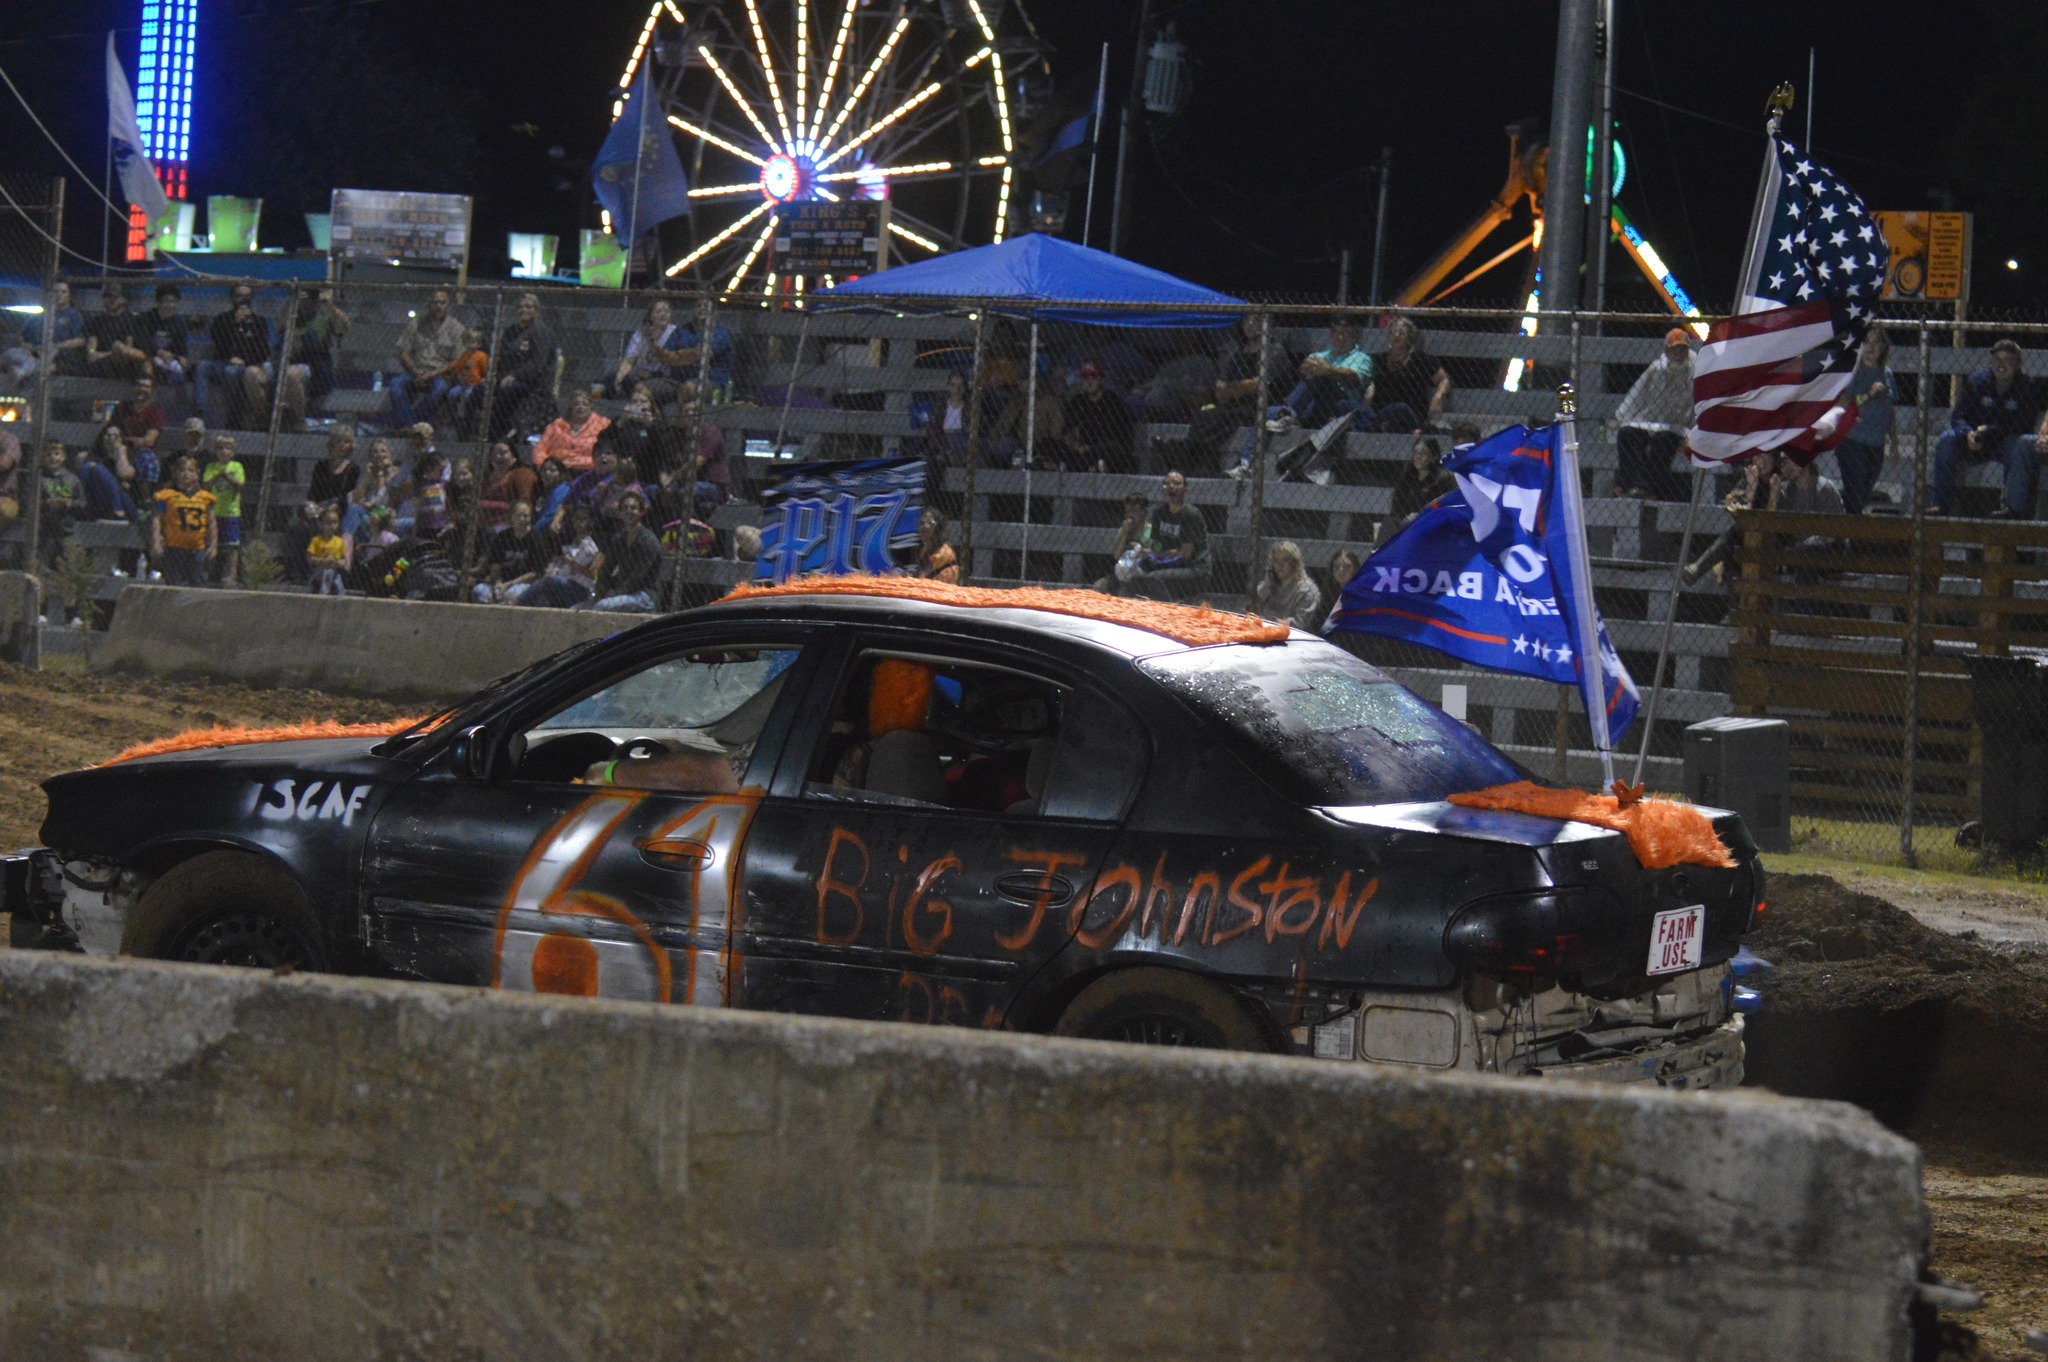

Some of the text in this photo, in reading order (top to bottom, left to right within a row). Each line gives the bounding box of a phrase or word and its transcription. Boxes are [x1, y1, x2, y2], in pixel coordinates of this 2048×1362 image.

[179, 506, 202, 532] 13
[1658, 916, 1697, 944] FARM
[1662, 942, 1689, 967] USE
